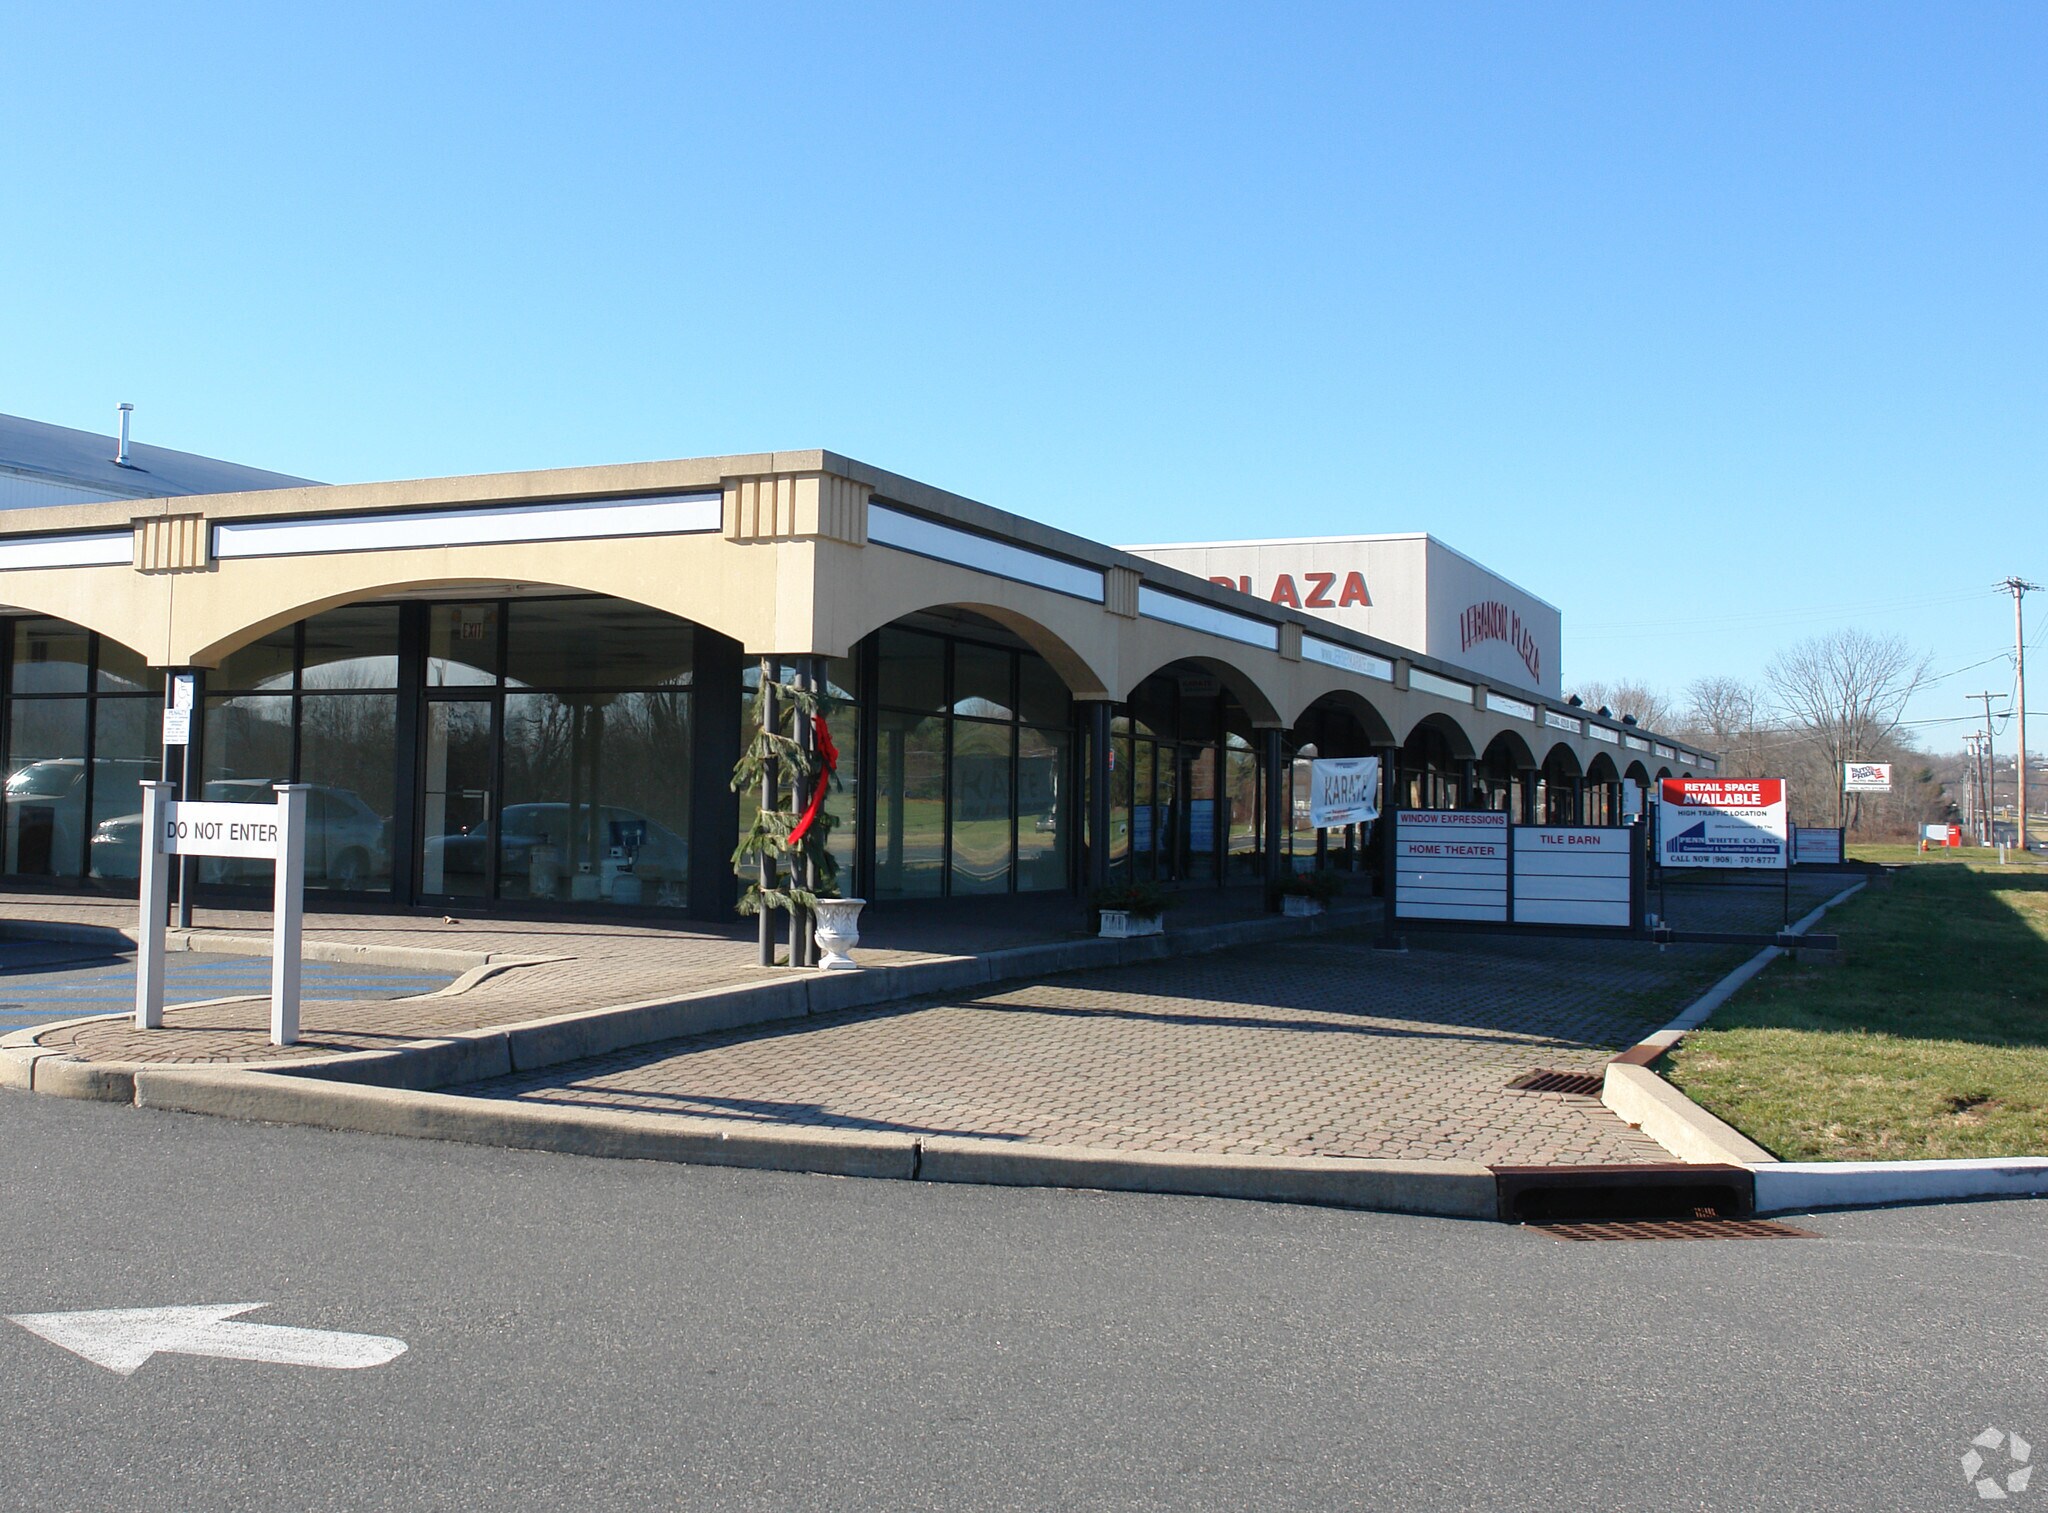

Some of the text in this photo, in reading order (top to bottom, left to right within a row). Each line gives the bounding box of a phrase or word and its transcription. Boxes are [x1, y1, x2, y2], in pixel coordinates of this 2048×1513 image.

[463, 622, 481, 639] EXIT
[1460, 601, 1540, 685] LEBANON PLAZA
[1324, 774, 1369, 806] KARATE
[1684, 783, 1760, 792] RETAIL SPACE
[1683, 793, 1761, 805] AVAILABLE
[1400, 814, 1505, 825] WINDOW EXPRESSIONS
[167, 821, 278, 842] DO NOT ENTER
[1539, 834, 1601, 845] TILE BARN
[1680, 836, 1705, 844] PENN
[1409, 844, 1495, 855] HOME THEATER
[1692, 855, 1710, 863] NOW
[1712, 855, 1733, 864] (908)
[1739, 856, 1777, 864] 707-8777
